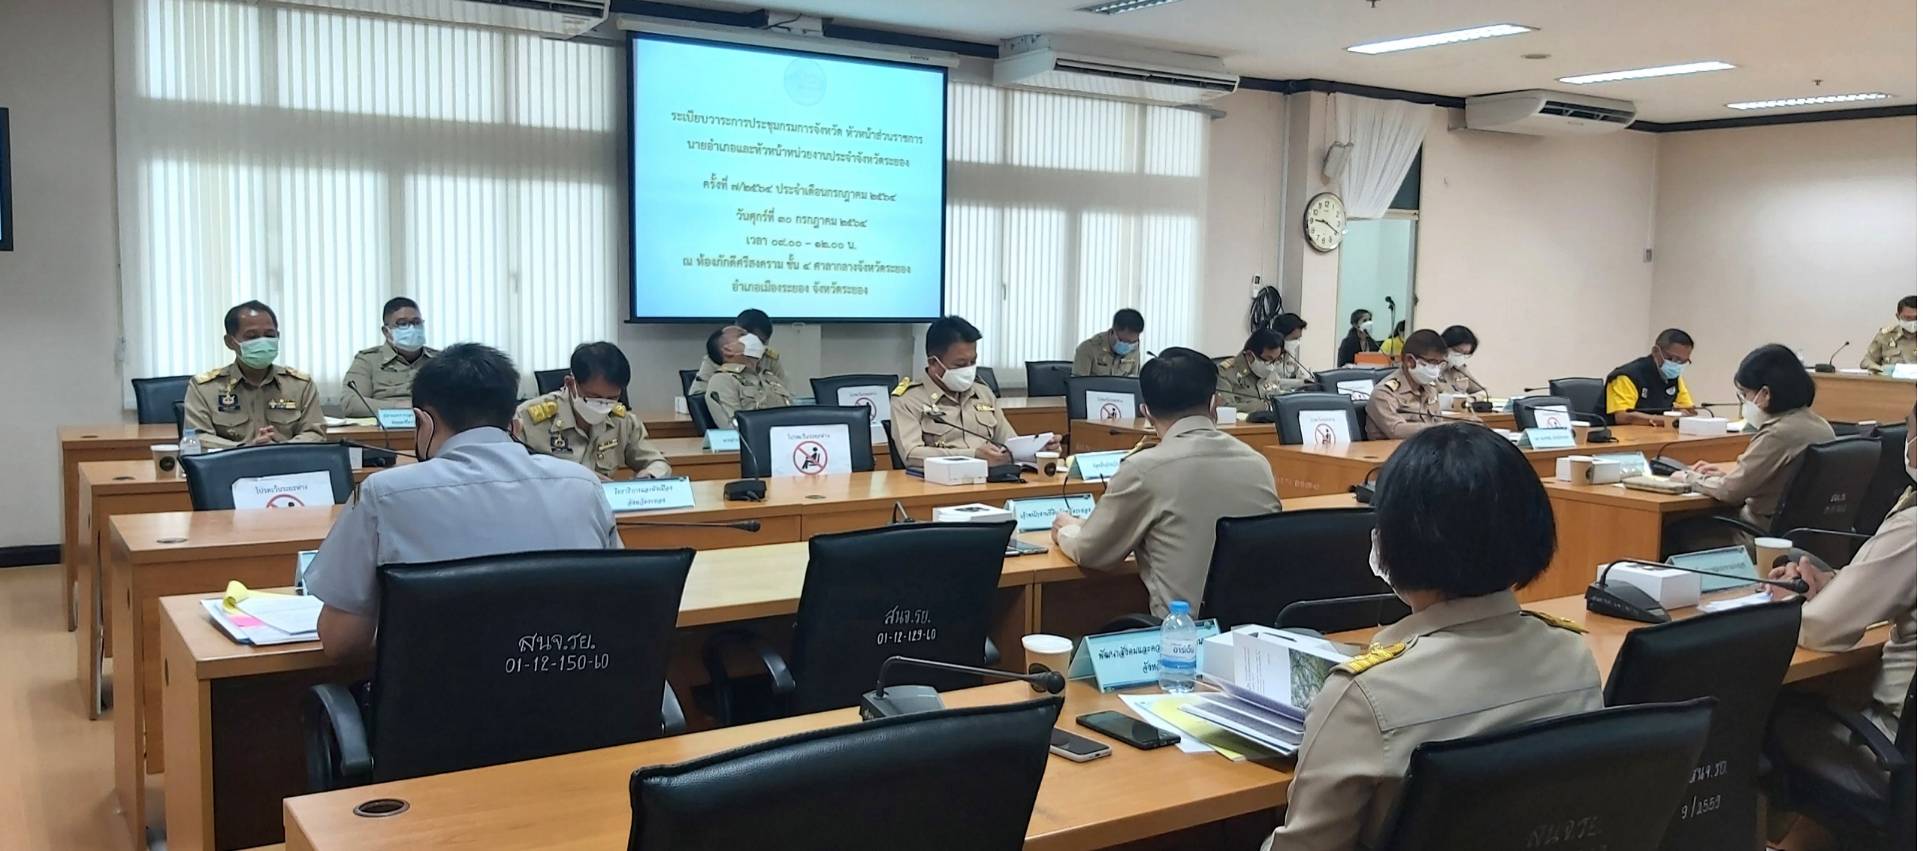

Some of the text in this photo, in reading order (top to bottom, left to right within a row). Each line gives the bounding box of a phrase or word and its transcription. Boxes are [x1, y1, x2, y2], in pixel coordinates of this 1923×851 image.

[703, 172, 728, 190] ครั้งที่
[736, 207, 775, 226] วันศุกร์ที่
[795, 215, 837, 229] กรกฎาคม
[746, 236, 768, 246] เวลา
[786, 253, 799, 270] ชั้น
[813, 281, 868, 295] จังหวัดระยอง
[519, 632, 596, 652] สนจ.รย.
